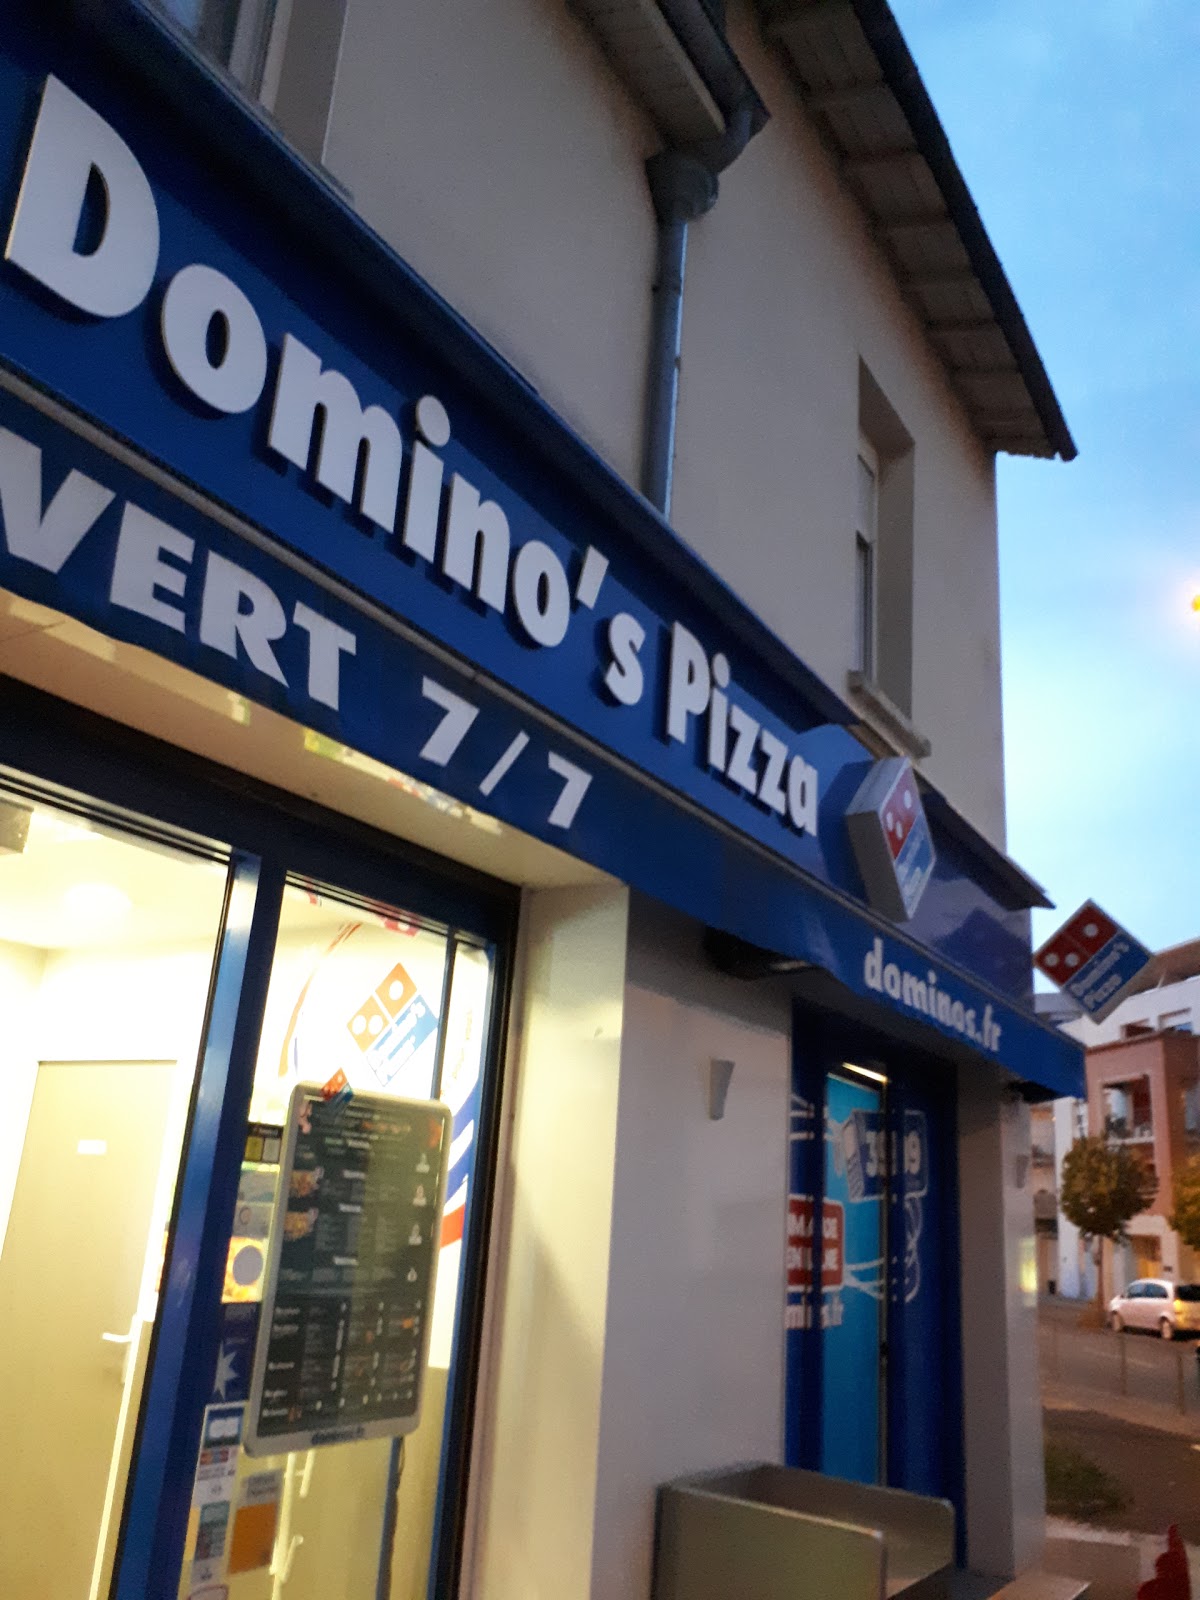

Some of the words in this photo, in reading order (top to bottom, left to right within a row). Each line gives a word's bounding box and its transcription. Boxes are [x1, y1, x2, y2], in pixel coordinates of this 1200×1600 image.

[0, 424, 357, 712] VERT
[4, 73, 646, 706] Domino's
[667, 619, 818, 837] Pizza
[864, 936, 1002, 1051] dominos.fr
